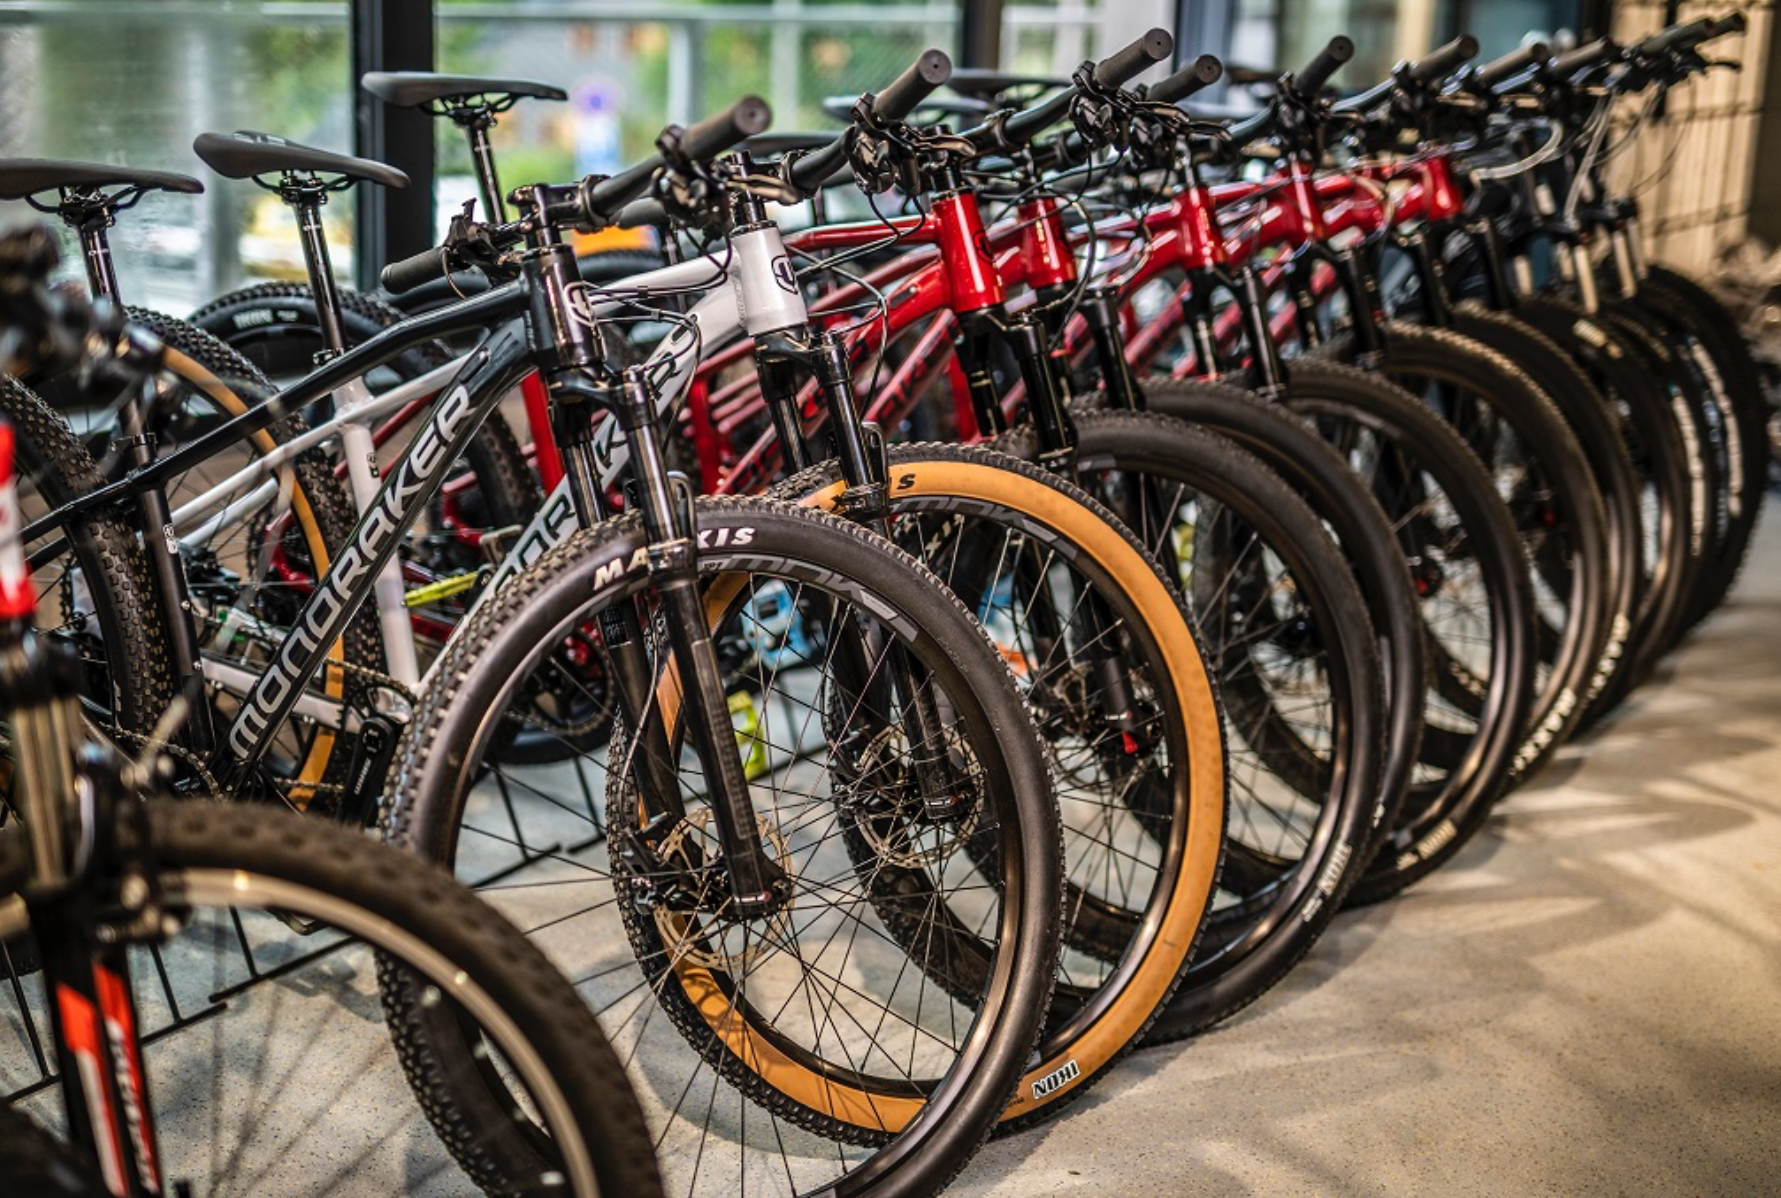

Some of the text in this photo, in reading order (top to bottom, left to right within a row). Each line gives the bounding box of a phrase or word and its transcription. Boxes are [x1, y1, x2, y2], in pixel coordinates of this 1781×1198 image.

[229, 385, 477, 759] MONDRAKER
[593, 526, 756, 591] MAXIS
[1031, 1059, 1081, 1100] IKON
